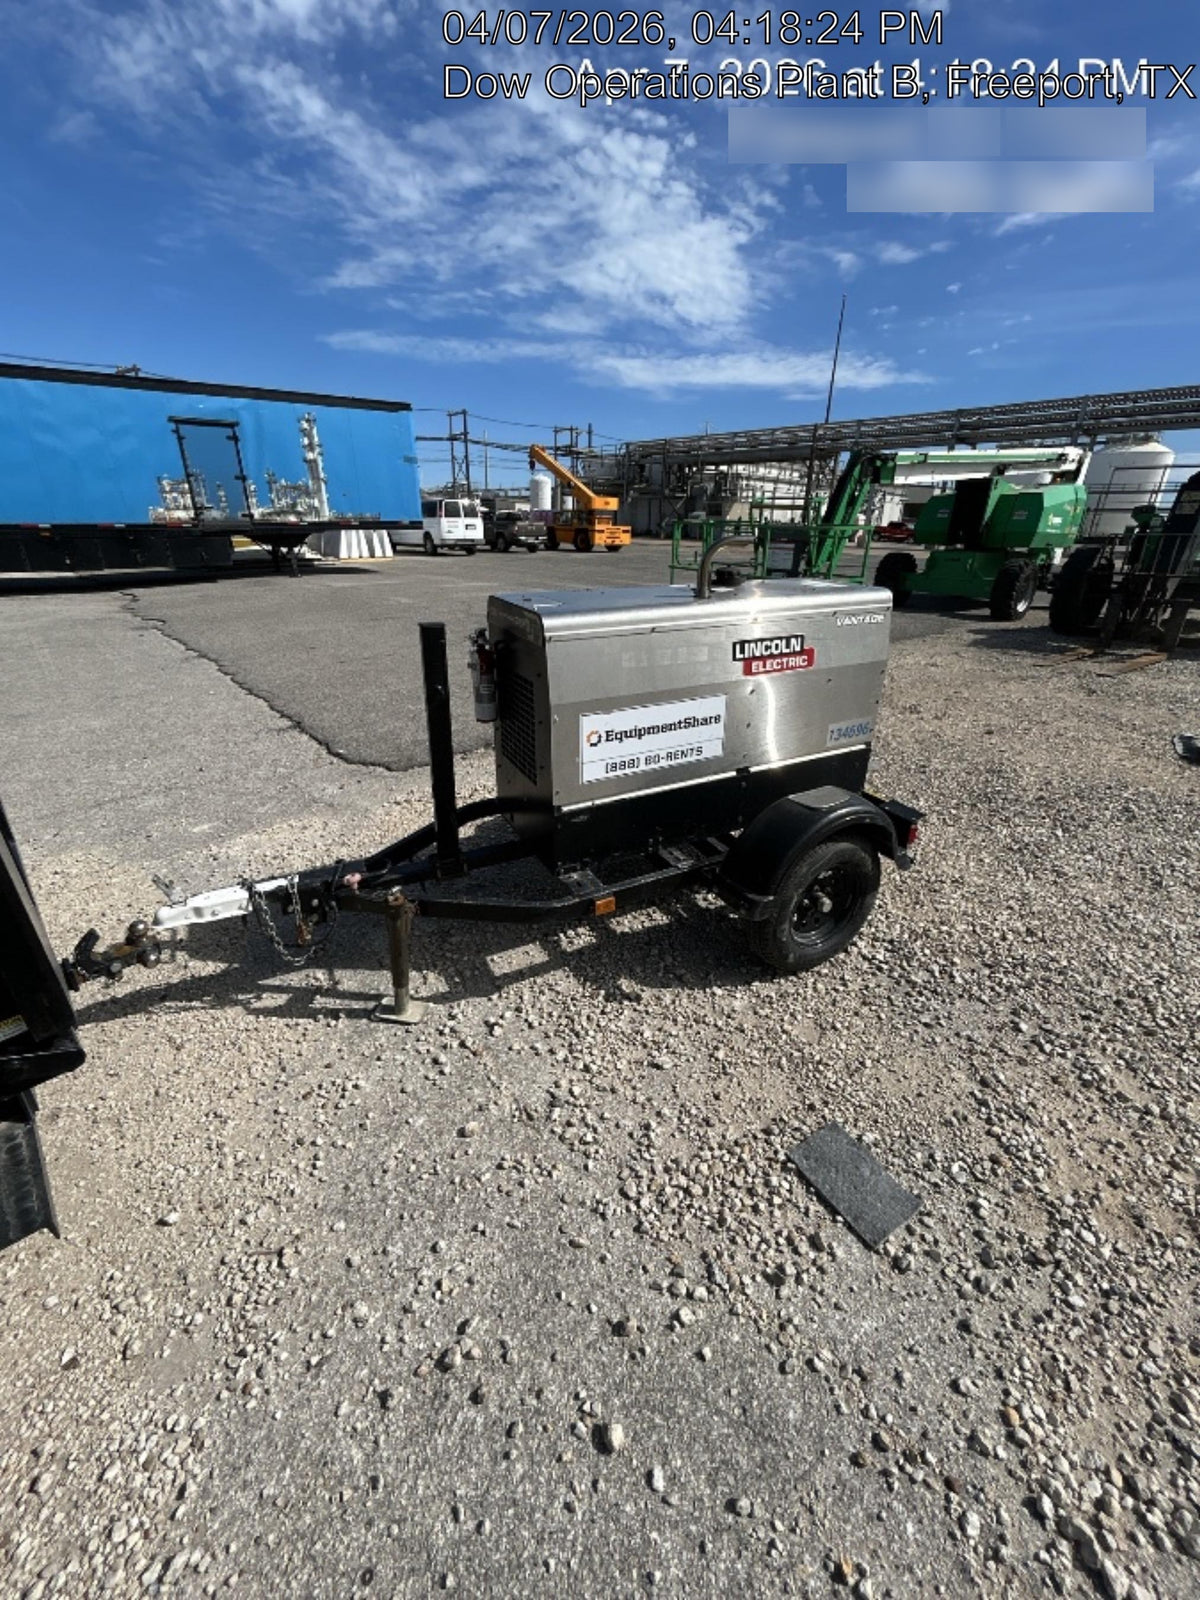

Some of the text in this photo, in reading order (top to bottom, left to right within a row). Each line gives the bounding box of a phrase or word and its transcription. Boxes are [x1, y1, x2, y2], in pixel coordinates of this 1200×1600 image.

[836, 614, 885, 627] VANTAGE
[735, 637, 801, 659] LINCOLN
[751, 655, 808, 673] ELECTRIC
[604, 714, 721, 744] EquipmentShare
